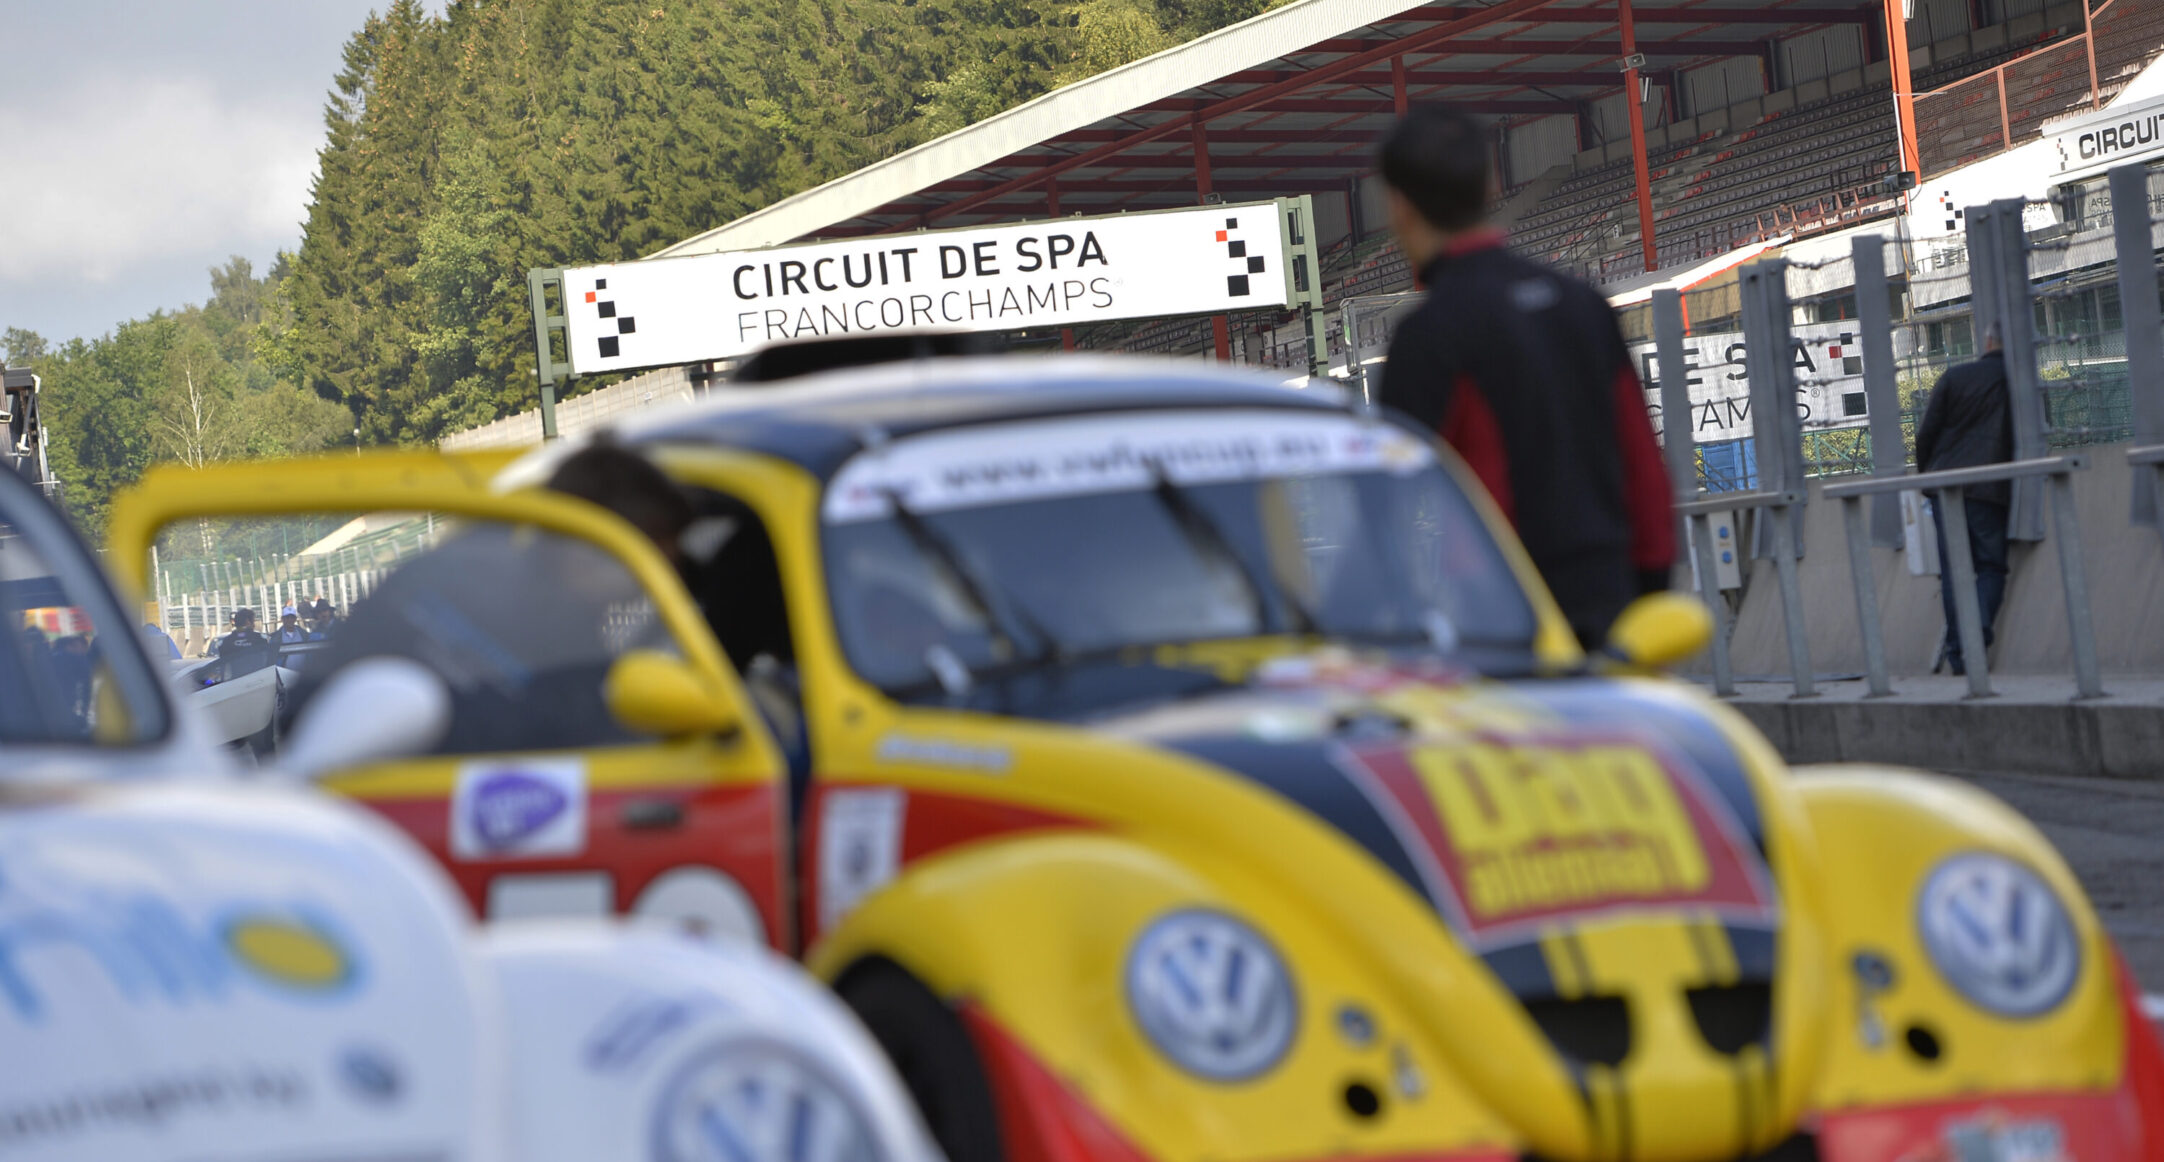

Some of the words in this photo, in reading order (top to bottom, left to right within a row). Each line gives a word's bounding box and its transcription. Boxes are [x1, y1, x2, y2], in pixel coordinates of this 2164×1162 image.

[733, 247, 918, 300] CIRCUIT
[939, 240, 1000, 279] DE
[1016, 231, 1109, 272] SPA
[738, 277, 1113, 343] FRANCORCHAMPS
[1725, 337, 1817, 381] SA
